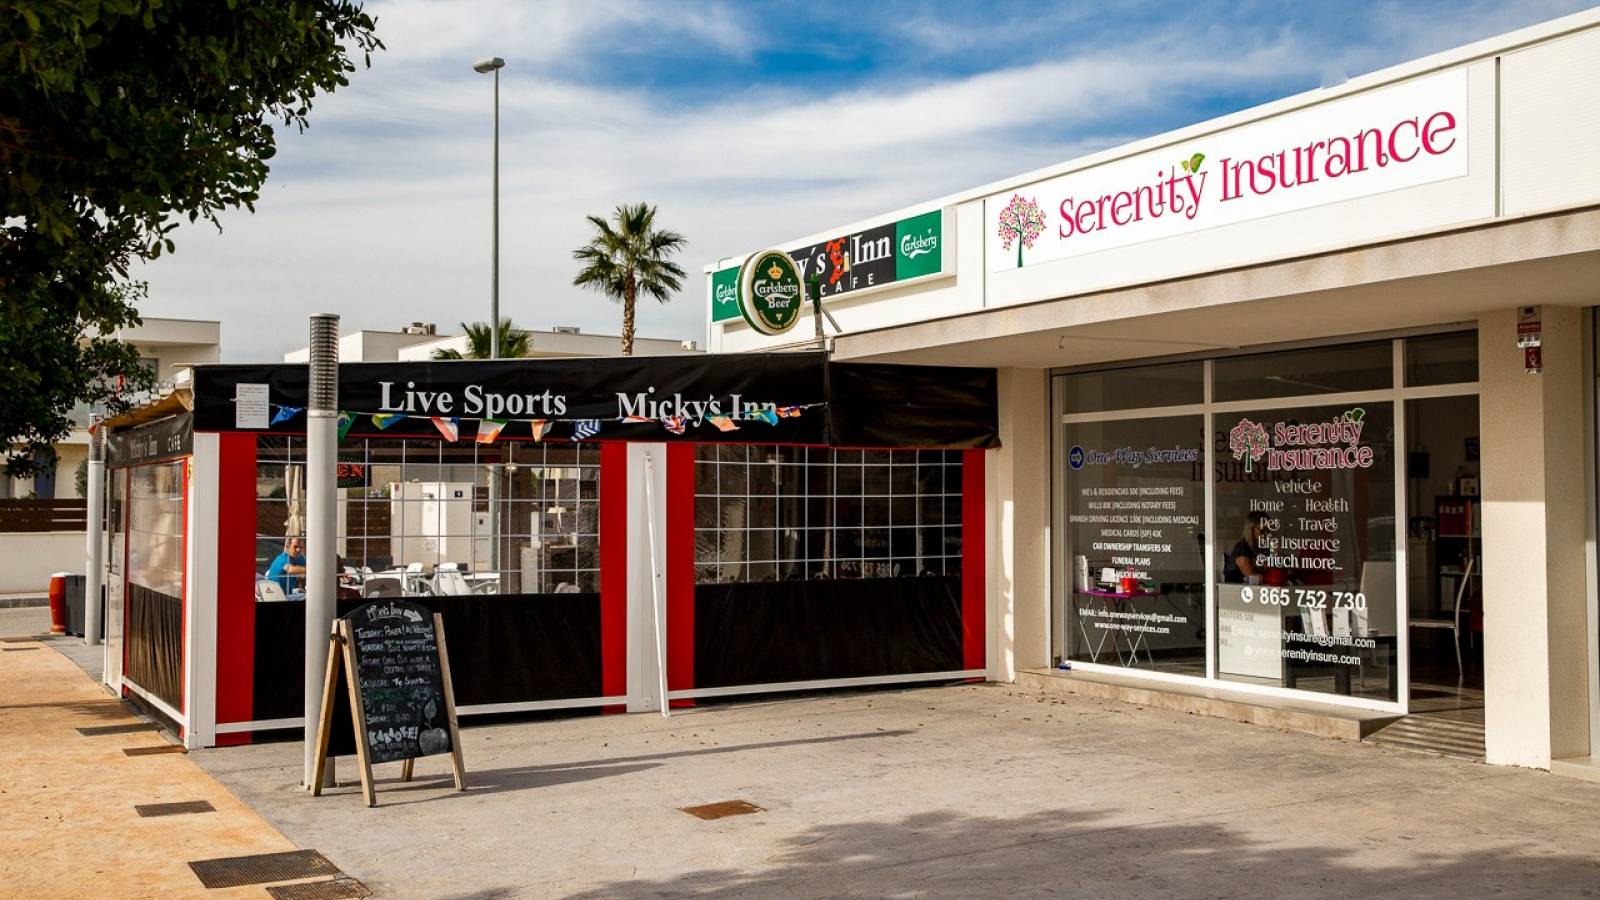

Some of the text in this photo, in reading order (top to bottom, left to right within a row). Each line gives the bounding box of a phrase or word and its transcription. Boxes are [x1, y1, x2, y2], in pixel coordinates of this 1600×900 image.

[1059, 111, 1457, 241] Serenity Insurance
[852, 234, 892, 266] Inn
[900, 229, 937, 259] Carlsberg
[754, 277, 798, 299] Carlsberg
[768, 297, 790, 308] Beer
[378, 381, 567, 419] Live Sports
[617, 386, 778, 428] Micky's Inn
[1274, 416, 1365, 450] Serenity
[1145, 445, 1199, 464] Services
[1266, 445, 1374, 471] Insurance
[1274, 479, 1323, 493] Vehicle
[1250, 499, 1285, 512] Home
[1305, 498, 1349, 513] Health
[1260, 518, 1280, 531] Pet
[1299, 517, 1338, 533] Travel
[1103, 542, 1132, 552] OWNERSHIP
[1133, 543, 1161, 552] TRANSFERS
[1258, 536, 1341, 552] Life Insurance
[1112, 557, 1151, 566] FUNERAL PLANS
[1267, 553, 1299, 568] much
[1259, 588, 1366, 611] 865 752 730
